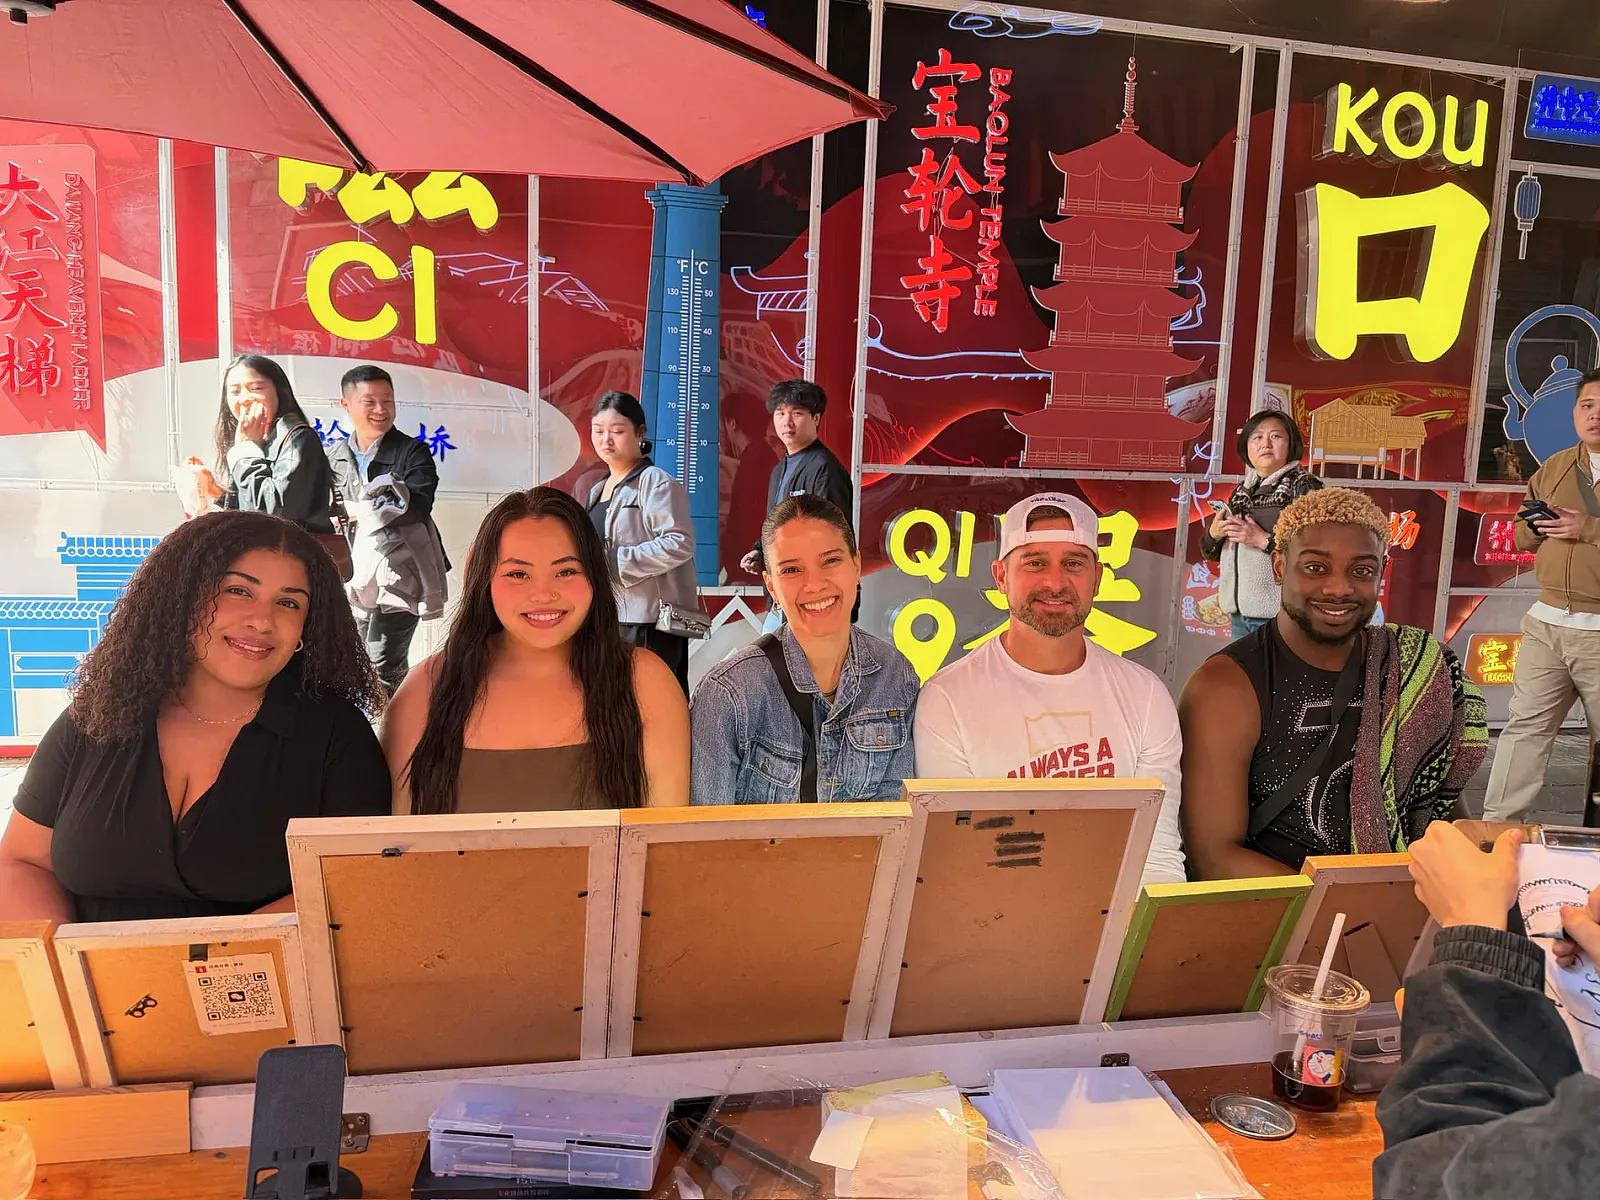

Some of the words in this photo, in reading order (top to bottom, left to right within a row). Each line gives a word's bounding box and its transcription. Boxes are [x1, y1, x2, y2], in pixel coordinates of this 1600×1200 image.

[983, 67, 1013, 193] BAOLUN
[1333, 82, 1489, 167] KOU
[63, 171, 84, 253] DAJIANG
[901, 48, 982, 333] 宝轮寺
[0, 160, 68, 397] 大江天梯
[66, 253, 88, 340] HEAVENLY
[306, 241, 437, 345] CI
[667, 288, 679, 296] 130
[974, 204, 1003, 317] TEMPLE
[1315, 182, 1490, 362] 口
[71, 343, 91, 410] LADDER
[668, 364, 677, 372] 90
[890, 509, 976, 584] QI
[1097, 736, 1114, 762] A
